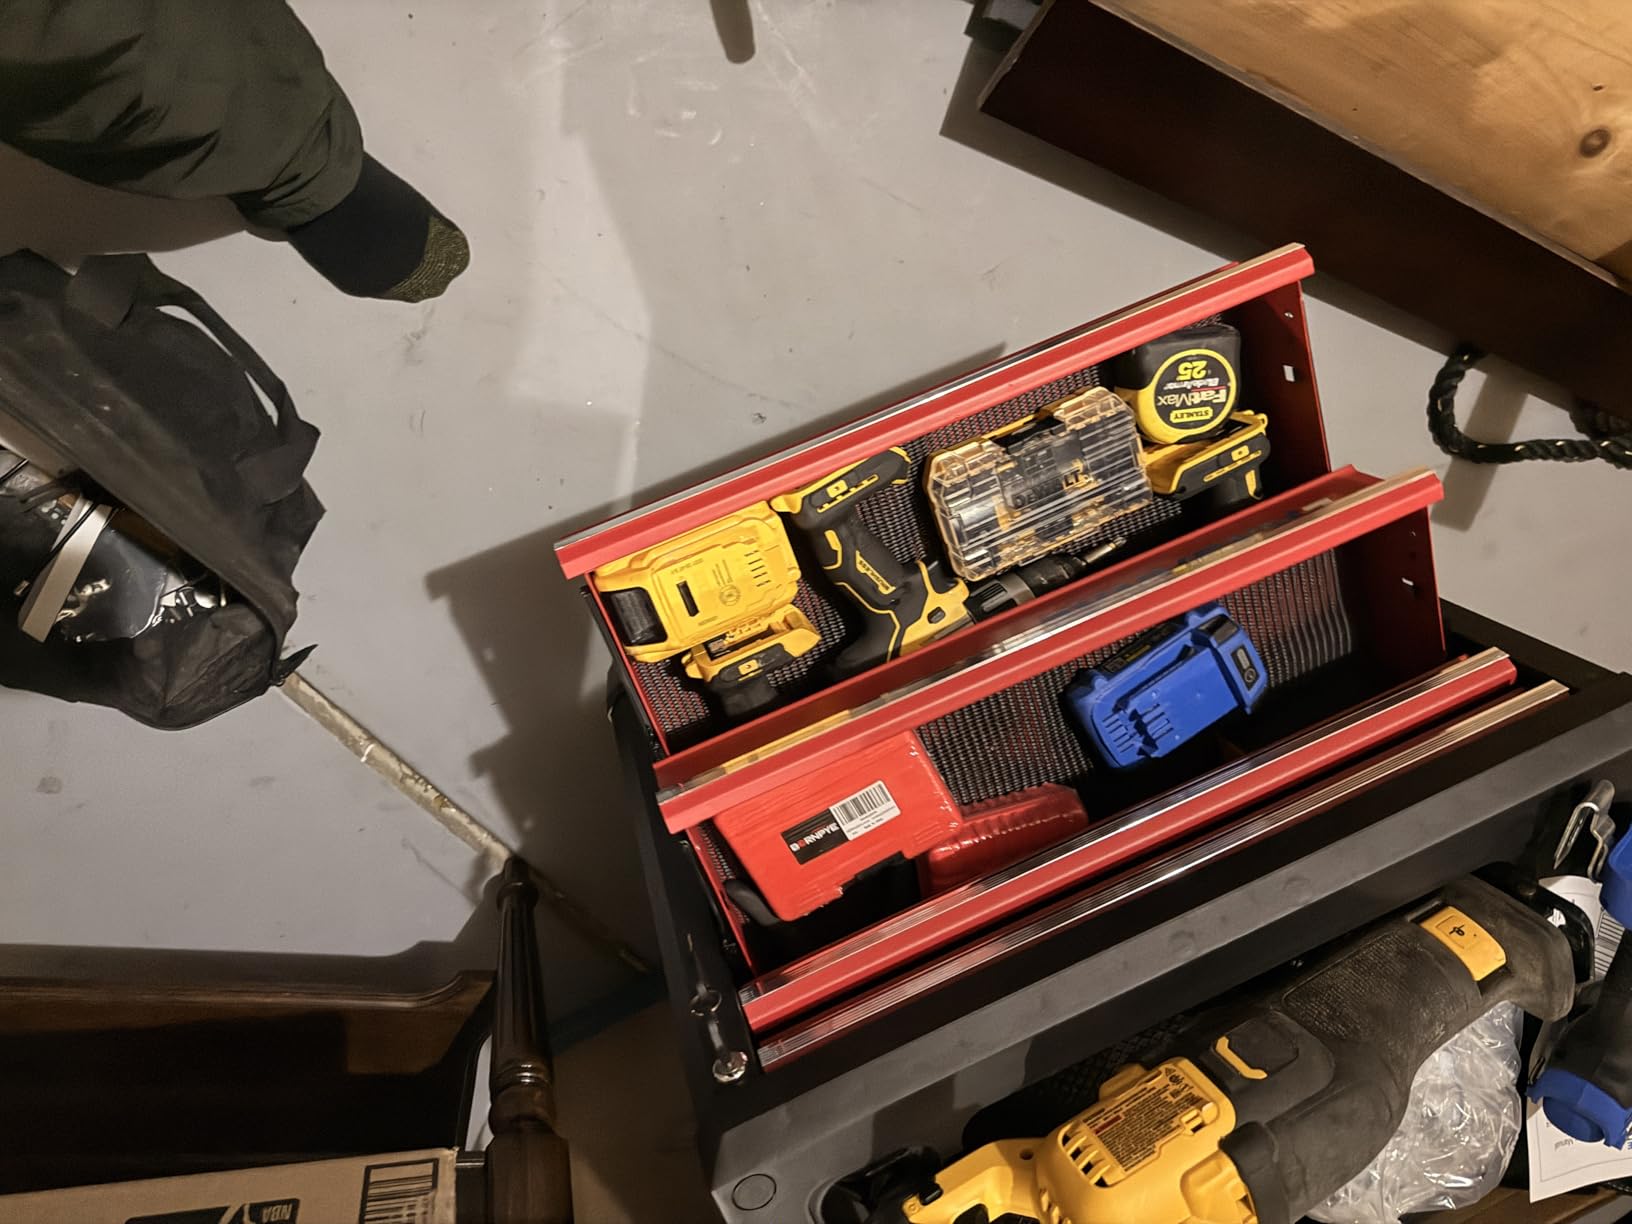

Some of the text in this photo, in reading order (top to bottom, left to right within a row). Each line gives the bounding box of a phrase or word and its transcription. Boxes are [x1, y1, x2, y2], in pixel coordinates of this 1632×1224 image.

[1177, 360, 1208, 380] 25
[1157, 388, 1227, 408] FatMax
[1174, 409, 1209, 420] STANLEY
[261, 1203, 293, 1222] NBA
